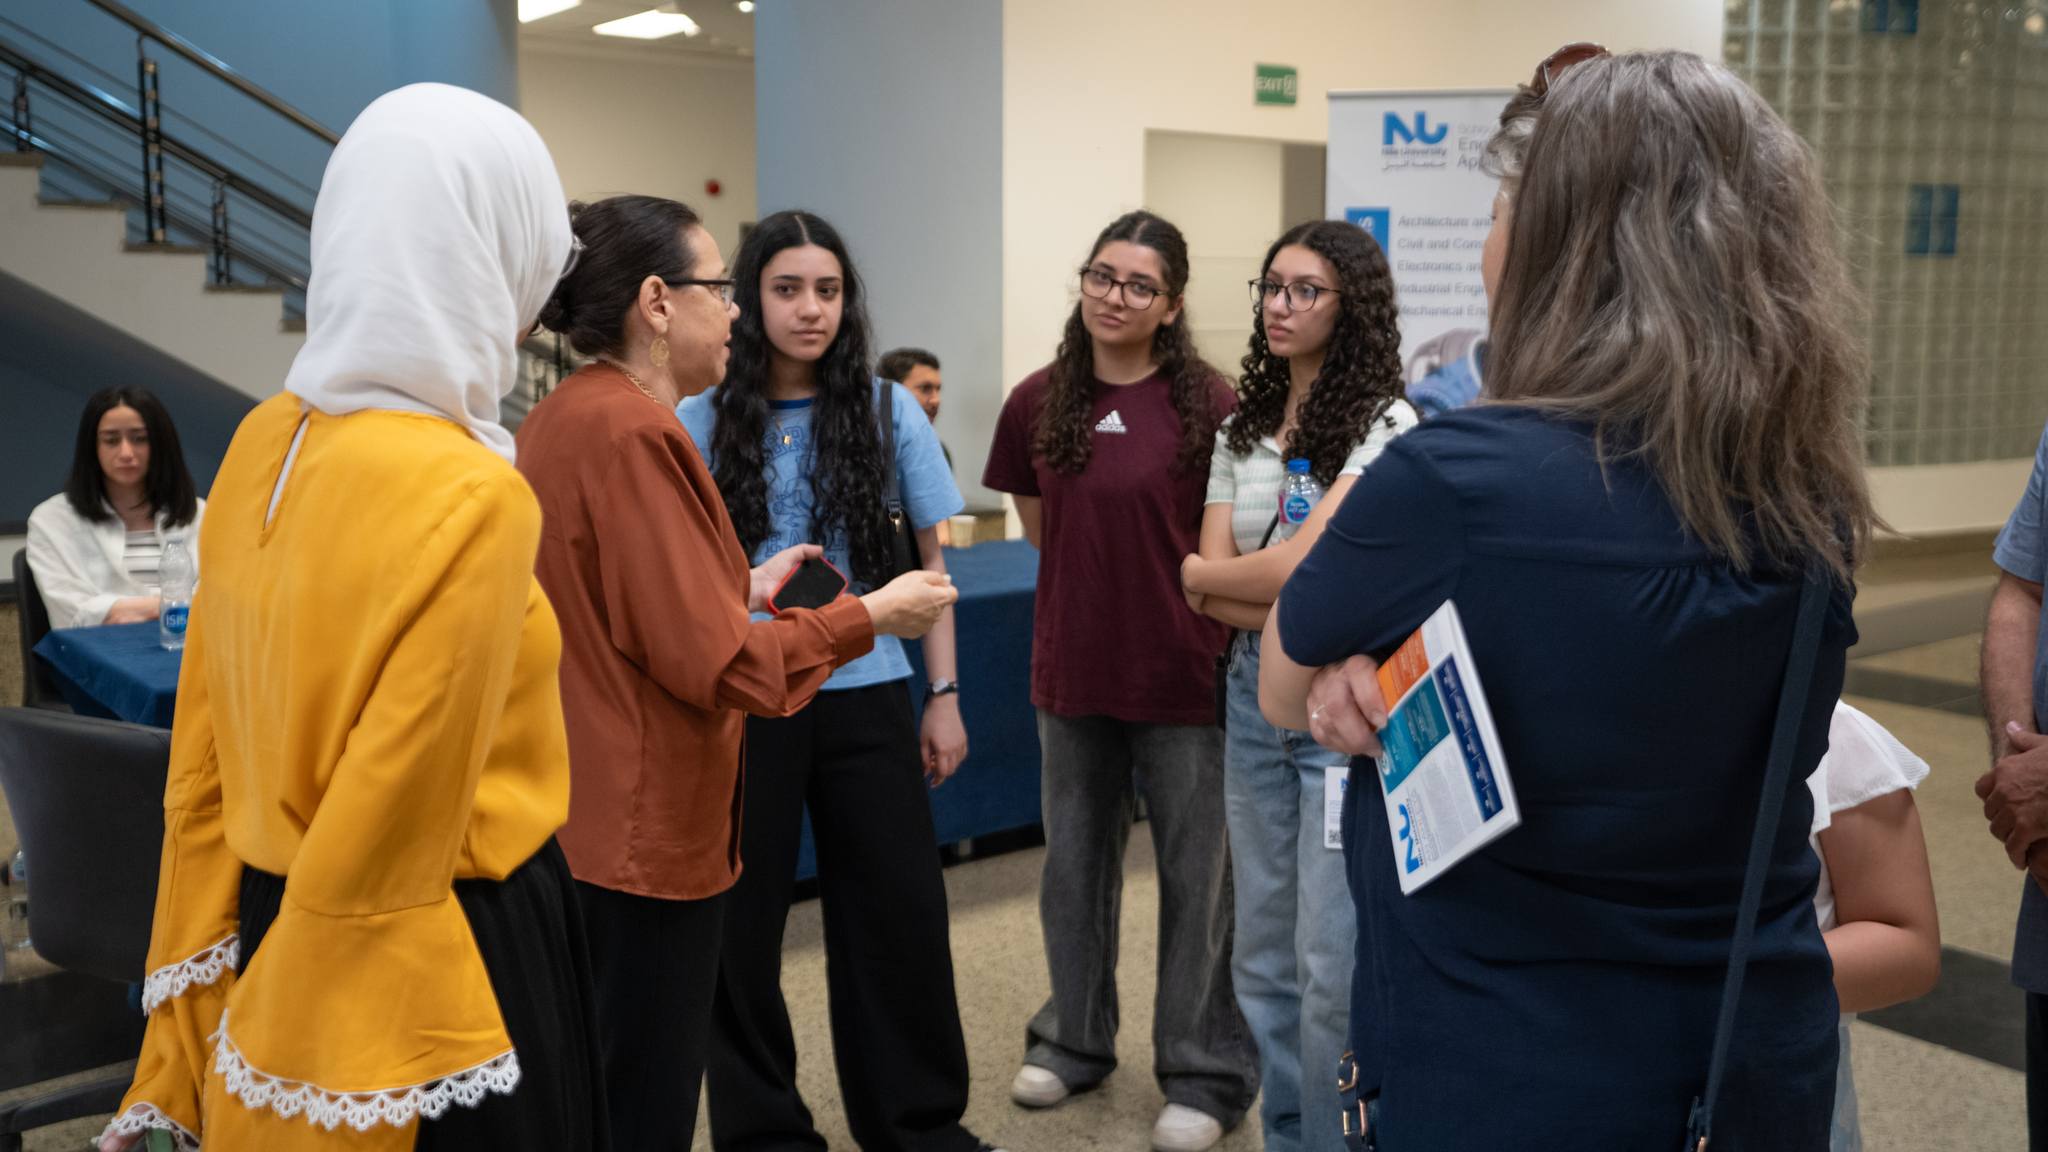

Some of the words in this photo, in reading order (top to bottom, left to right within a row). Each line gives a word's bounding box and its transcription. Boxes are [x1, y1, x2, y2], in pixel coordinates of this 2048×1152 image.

[1256, 77, 1282, 90] EXIT
[1382, 111, 1448, 145] NU
[1398, 216, 1468, 227] Architecture
[1398, 238, 1424, 249] Civil
[1427, 238, 1450, 249] and
[1397, 260, 1462, 272] Electronics
[1095, 423, 1126, 433] adidas
[1398, 804, 1420, 874] NU
